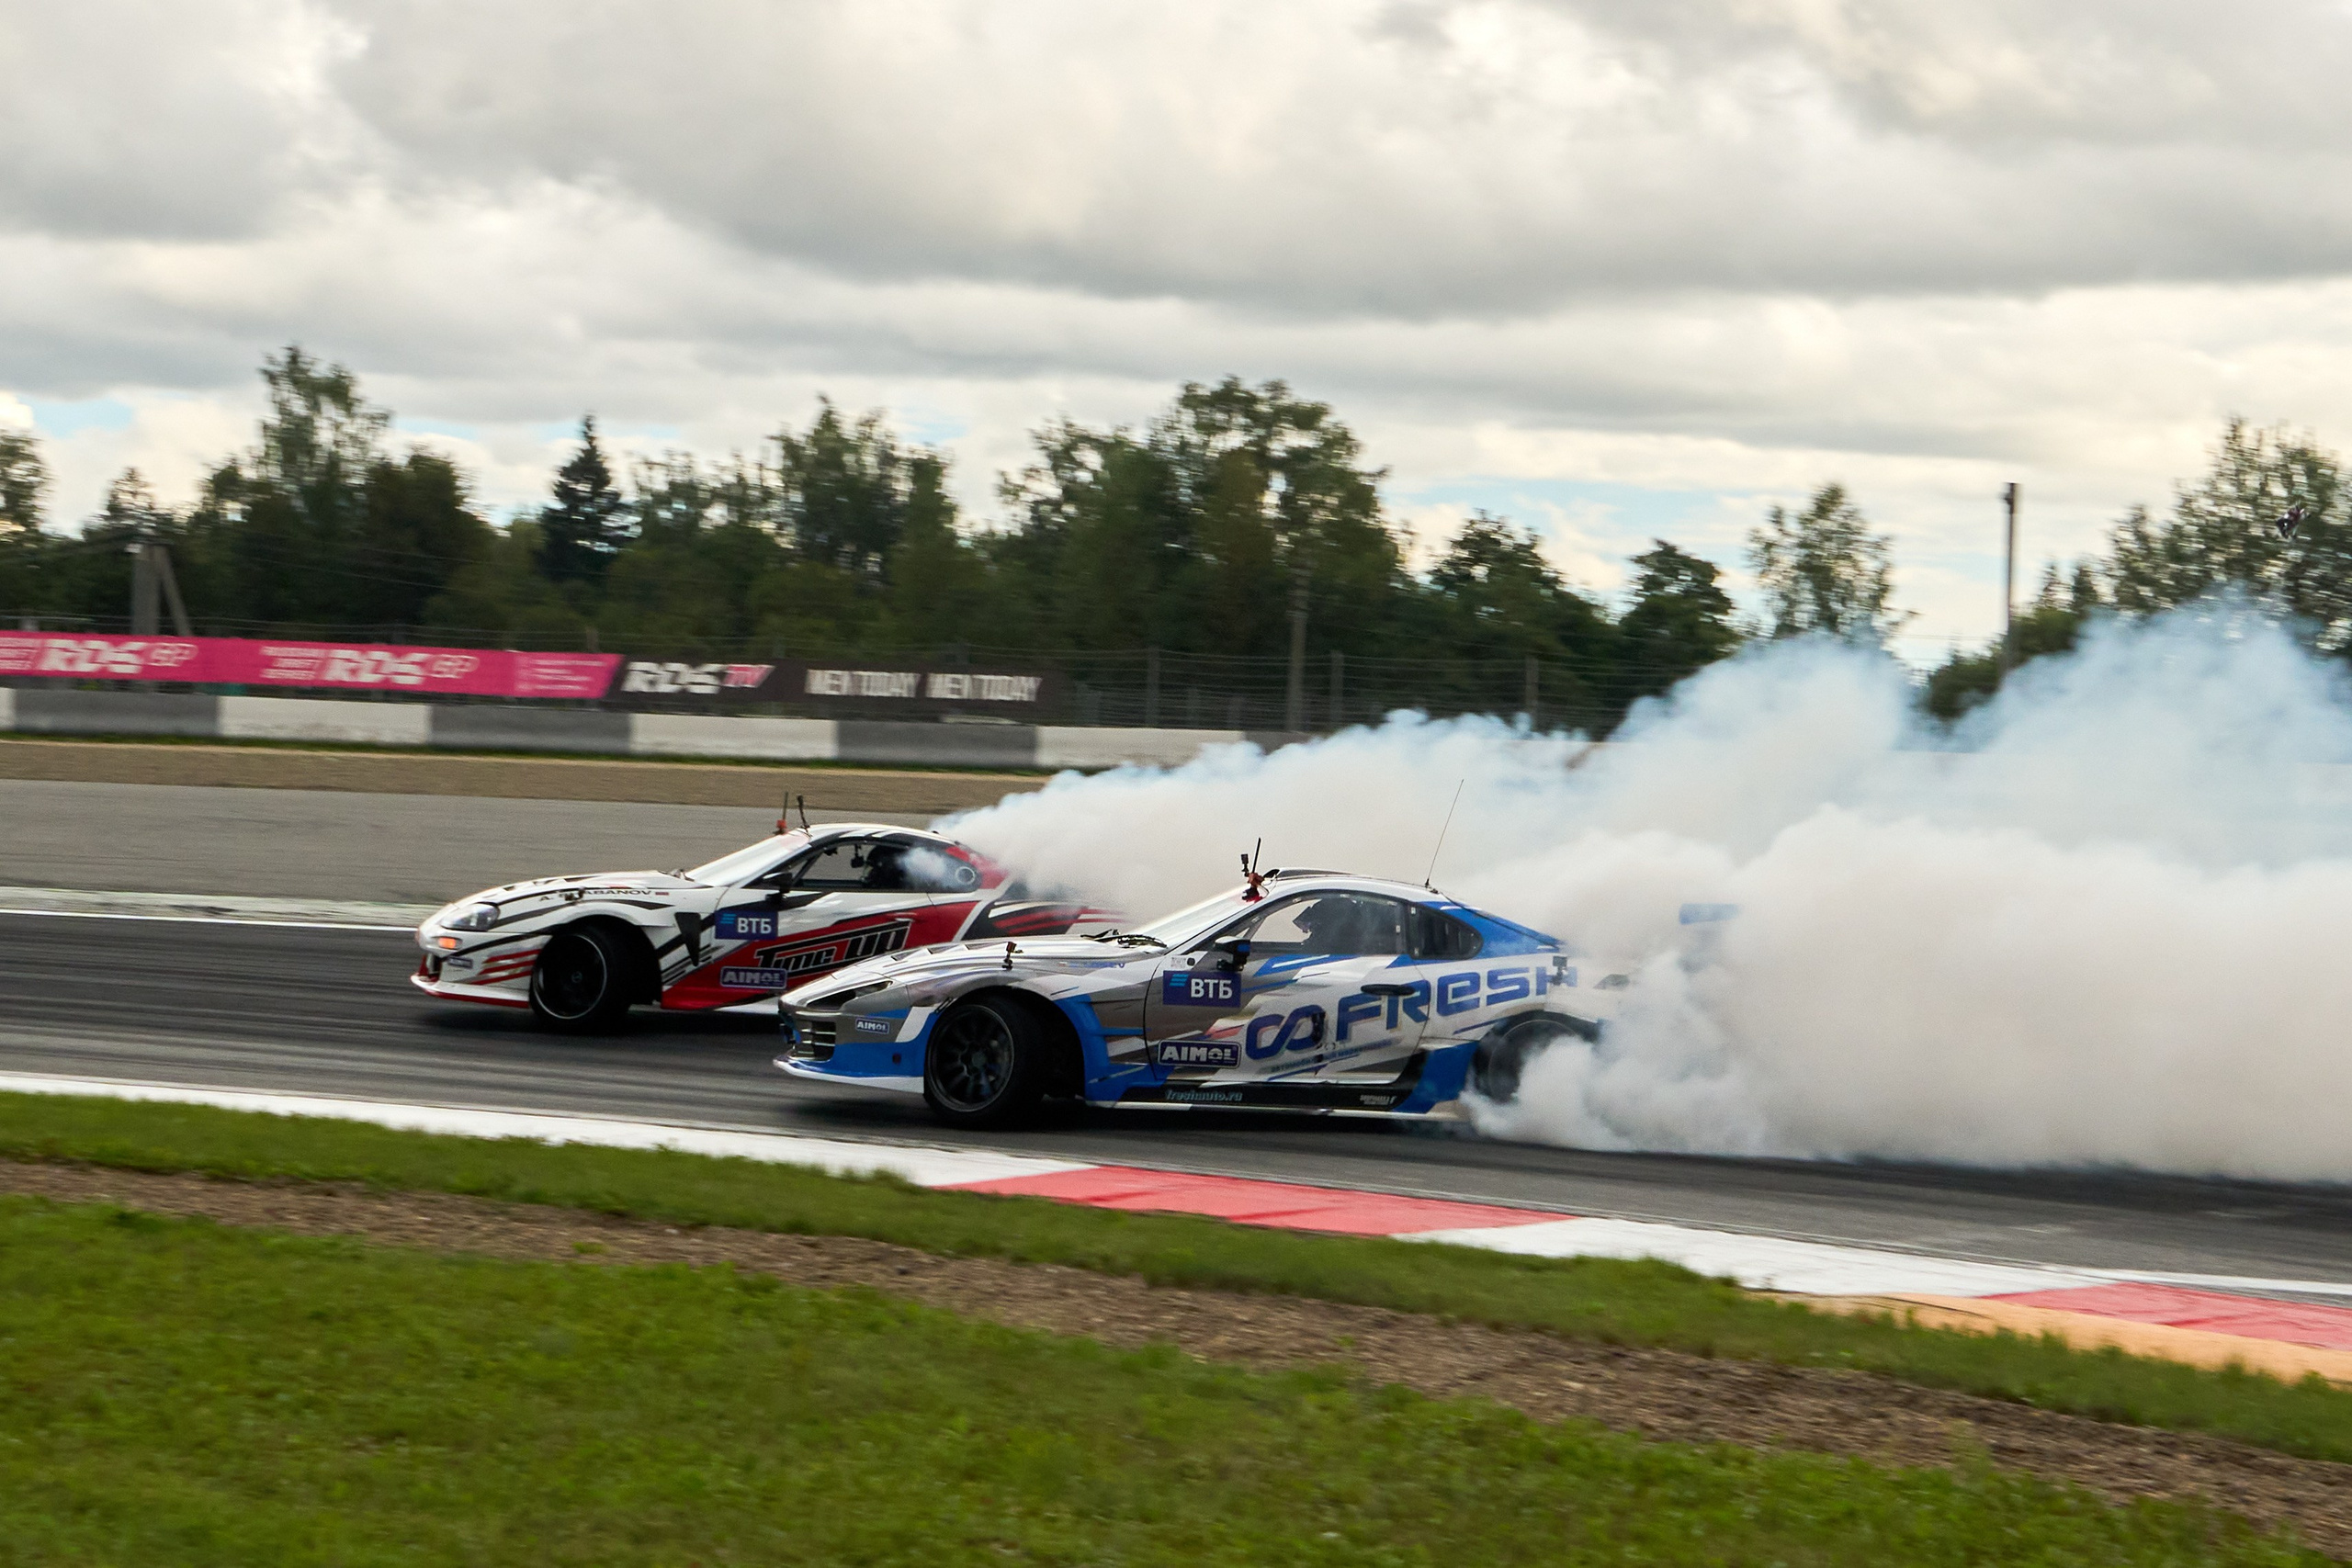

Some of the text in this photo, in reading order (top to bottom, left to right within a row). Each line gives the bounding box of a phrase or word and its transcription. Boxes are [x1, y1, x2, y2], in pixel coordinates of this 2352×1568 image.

[38, 637, 147, 674] RDS
[324, 649, 432, 685] RDS
[620, 661, 728, 694] RDS
[737, 918, 773, 935] ВТБ
[722, 971, 782, 985] AIMOL
[1191, 977, 1233, 1000] ВТБ
[857, 1021, 887, 1031] AIMOL
[1161, 1045, 1237, 1062] AIMOL
